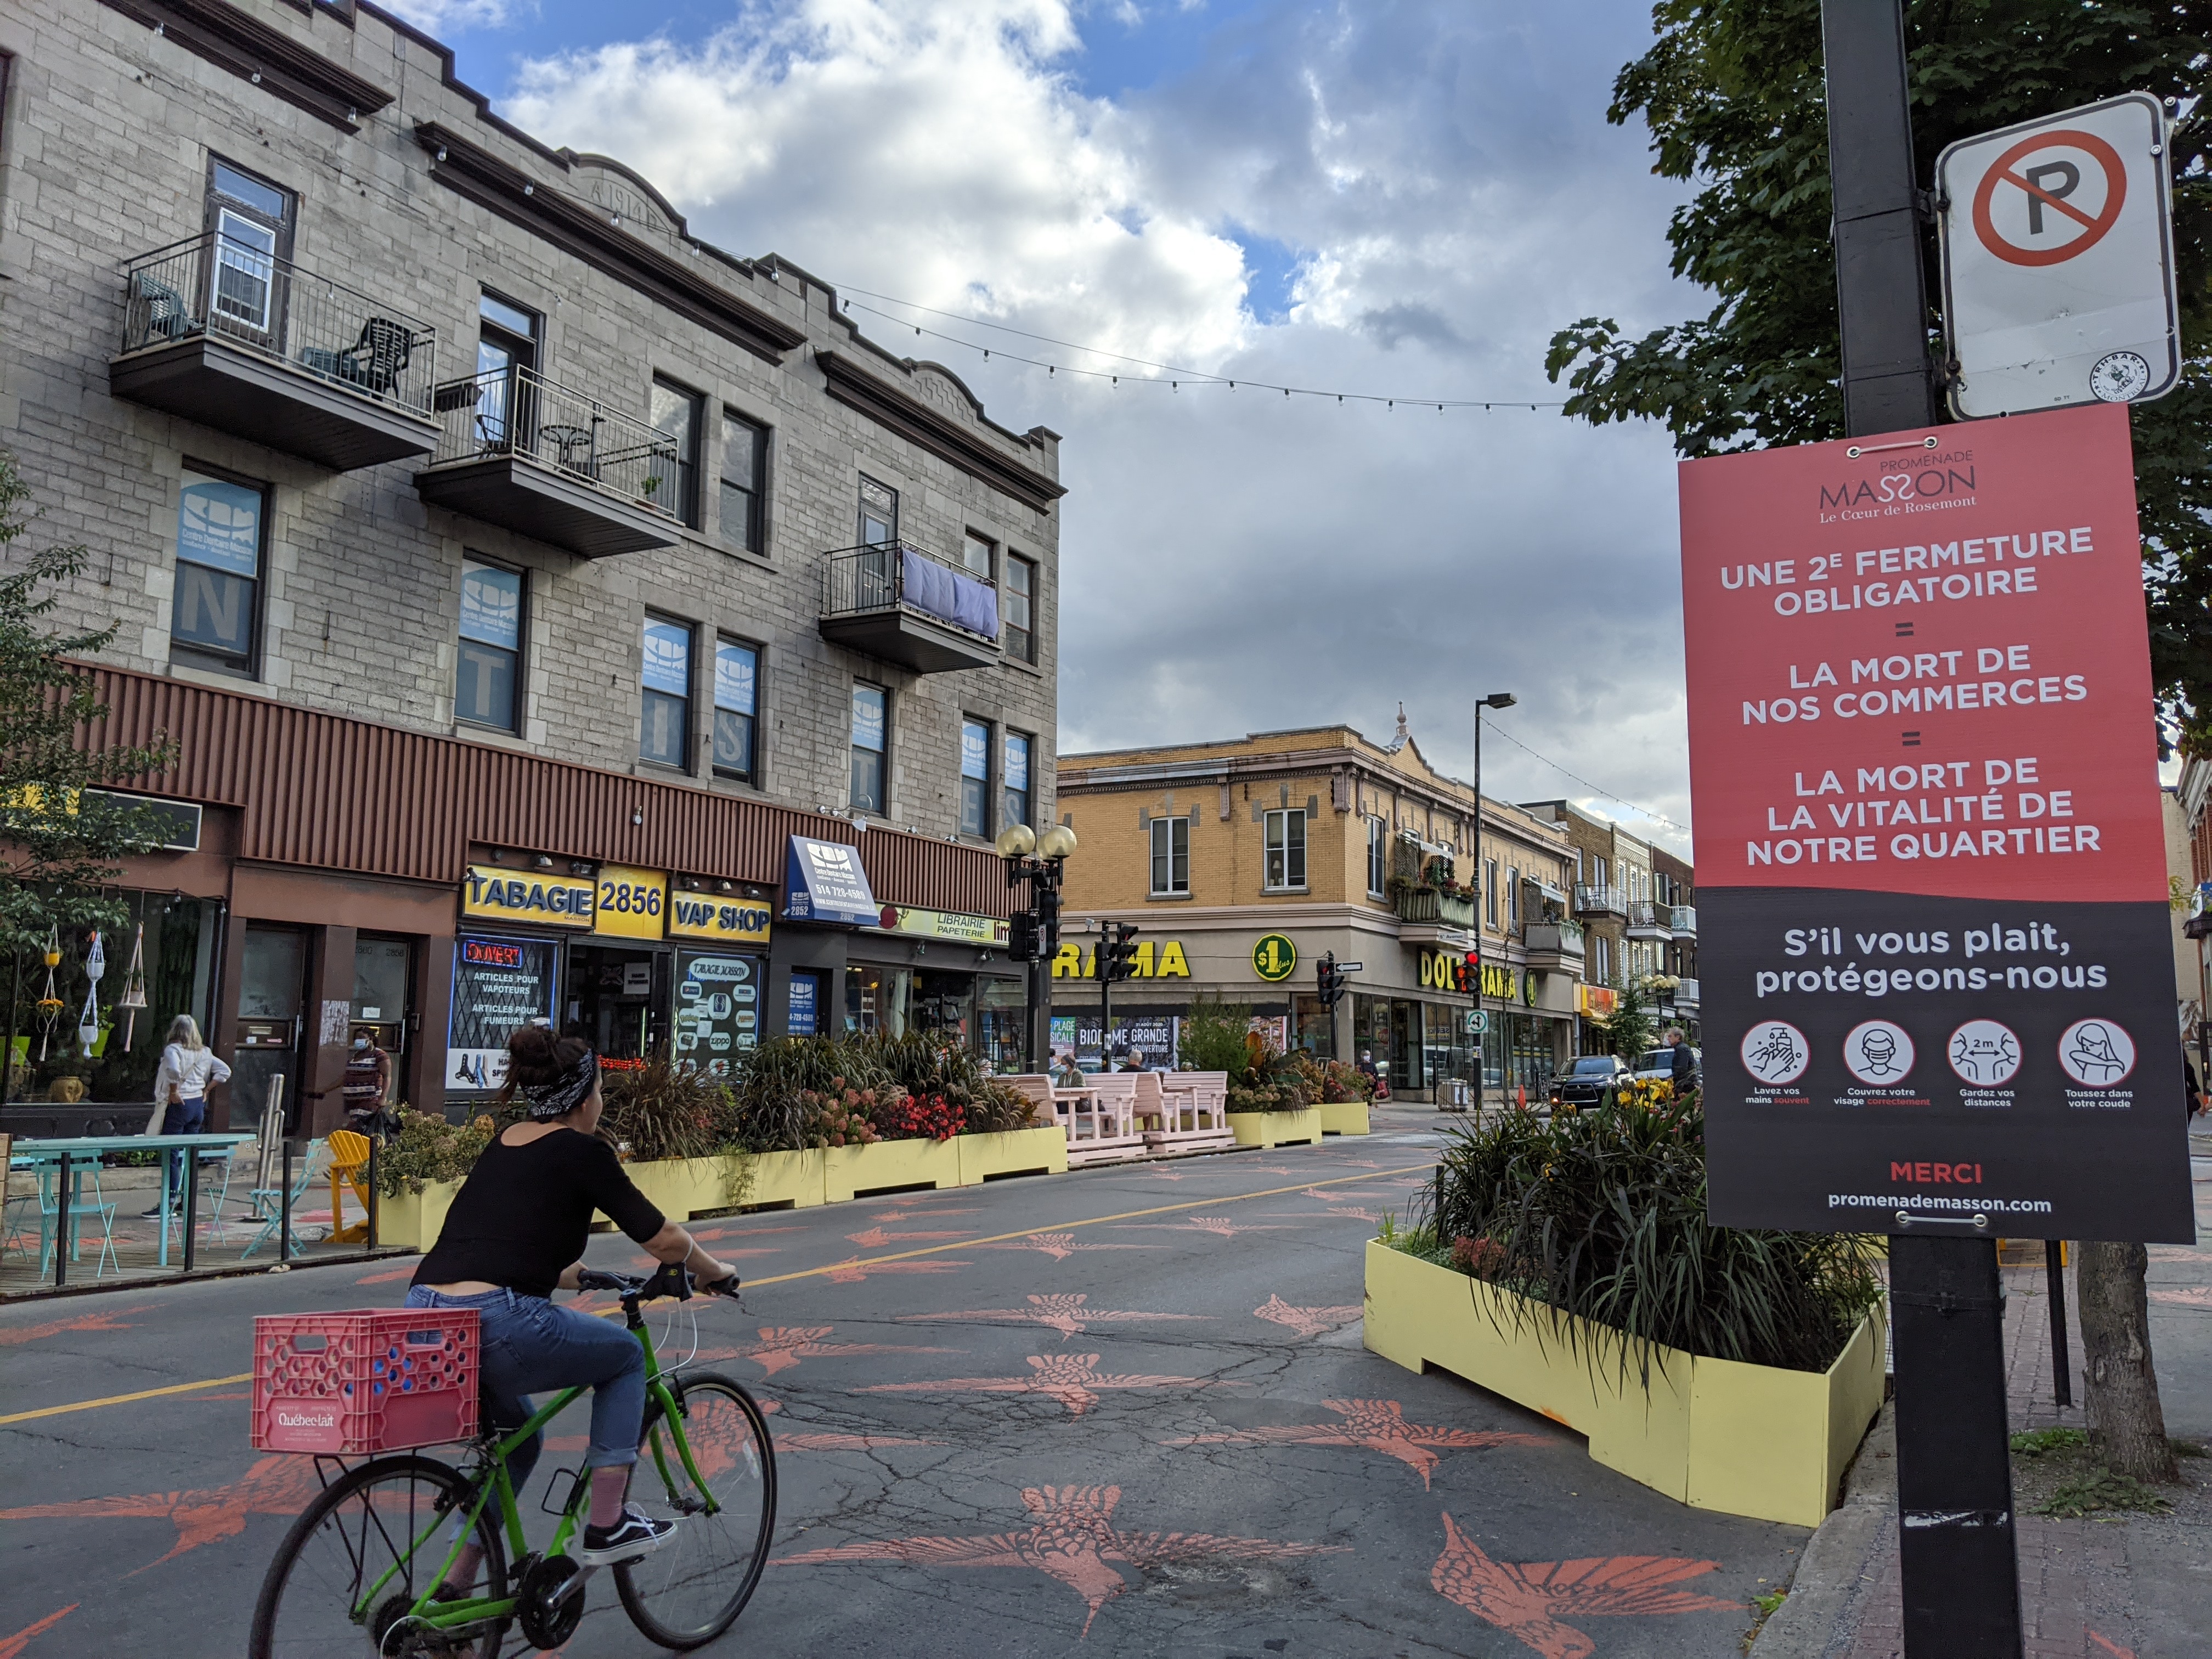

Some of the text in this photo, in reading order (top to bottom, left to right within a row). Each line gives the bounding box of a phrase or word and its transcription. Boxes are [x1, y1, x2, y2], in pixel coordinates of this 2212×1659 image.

[2092, 353, 2138, 381] TRH-BAR
[1880, 450, 1973, 472] PROMENADE
[1820, 465, 1976, 510] MASSON
[1820, 495, 1977, 523] Le Cœur de Rosemont
[1721, 560, 1796, 590] UNE
[1855, 526, 2094, 576] FERMETURE
[1774, 566, 2038, 616] OBLIGATOIRE
[1789, 644, 2031, 690] LA MORT DE
[181, 568, 240, 642] N
[464, 650, 505, 716] T
[718, 713, 744, 762] S
[962, 783, 978, 828] E
[1742, 675, 2087, 725] NOS COMMERCES
[1795, 757, 2040, 797] LA MORT DE
[1768, 787, 2074, 831] LA VITALITÉ DE
[1747, 825, 2102, 866] NOTRE QUARTIER
[815, 867, 827, 876] Centre
[469, 876, 594, 916] TABAGIE
[599, 880, 662, 916] 2856
[816, 884, 866, 900] 514 728-4589
[675, 900, 771, 934] VAP SHOP
[791, 906, 809, 916] 2852
[840, 912, 855, 922] 2852
[937, 912, 986, 929] LIBRAIRIE
[937, 926, 986, 938] PAPETERIE
[1784, 922, 2070, 958] S'il vous plait,
[467, 943, 520, 964] OUVERT
[473, 972, 539, 984] ARTICLES POUR
[693, 963, 720, 975] TABAGIE
[719, 964, 747, 977] MASSON
[1421, 950, 1517, 999] DOLRAMA
[1756, 962, 2107, 998] protégeons-nous
[482, 984, 531, 995] VAPOTEURS
[472, 1003, 538, 1015] ARTICLES POUR
[484, 1016, 524, 1025] FUMEURS
[1054, 1020, 1075, 1031] PLAGE
[710, 1036, 730, 1048] zippo
[1080, 1028, 1169, 1046] BIODME GRANDE
[1833, 1098, 1865, 1107] visage
[1847, 1088, 1887, 1096] Couvrez
[1959, 1088, 1995, 1097] Gardez
[2064, 1089, 2133, 1098] Toussez dans
[1964, 1099, 2011, 1107] distances
[2098, 1099, 2131, 1108] coude
[1890, 1161, 1982, 1184] MERCI
[1827, 1192, 2052, 1213] promenademasson.com
